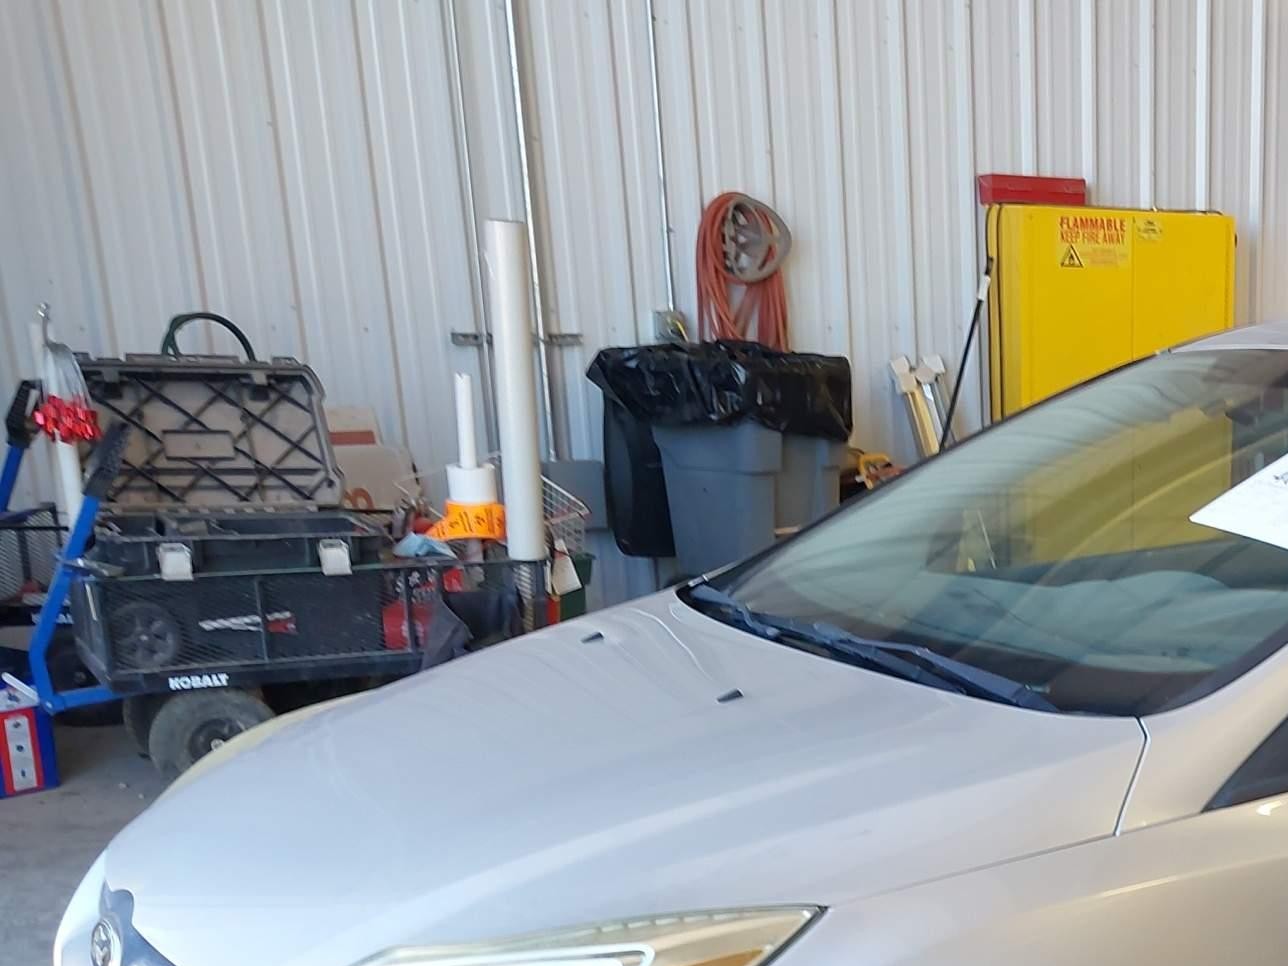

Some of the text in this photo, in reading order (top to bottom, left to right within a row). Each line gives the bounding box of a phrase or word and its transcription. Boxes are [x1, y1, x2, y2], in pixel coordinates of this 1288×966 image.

[1060, 216, 1126, 232] FLAMMABLE
[1060, 230, 1081, 244] KEEP
[1103, 231, 1125, 245] AWAY
[168, 672, 229, 690] KOBALT
